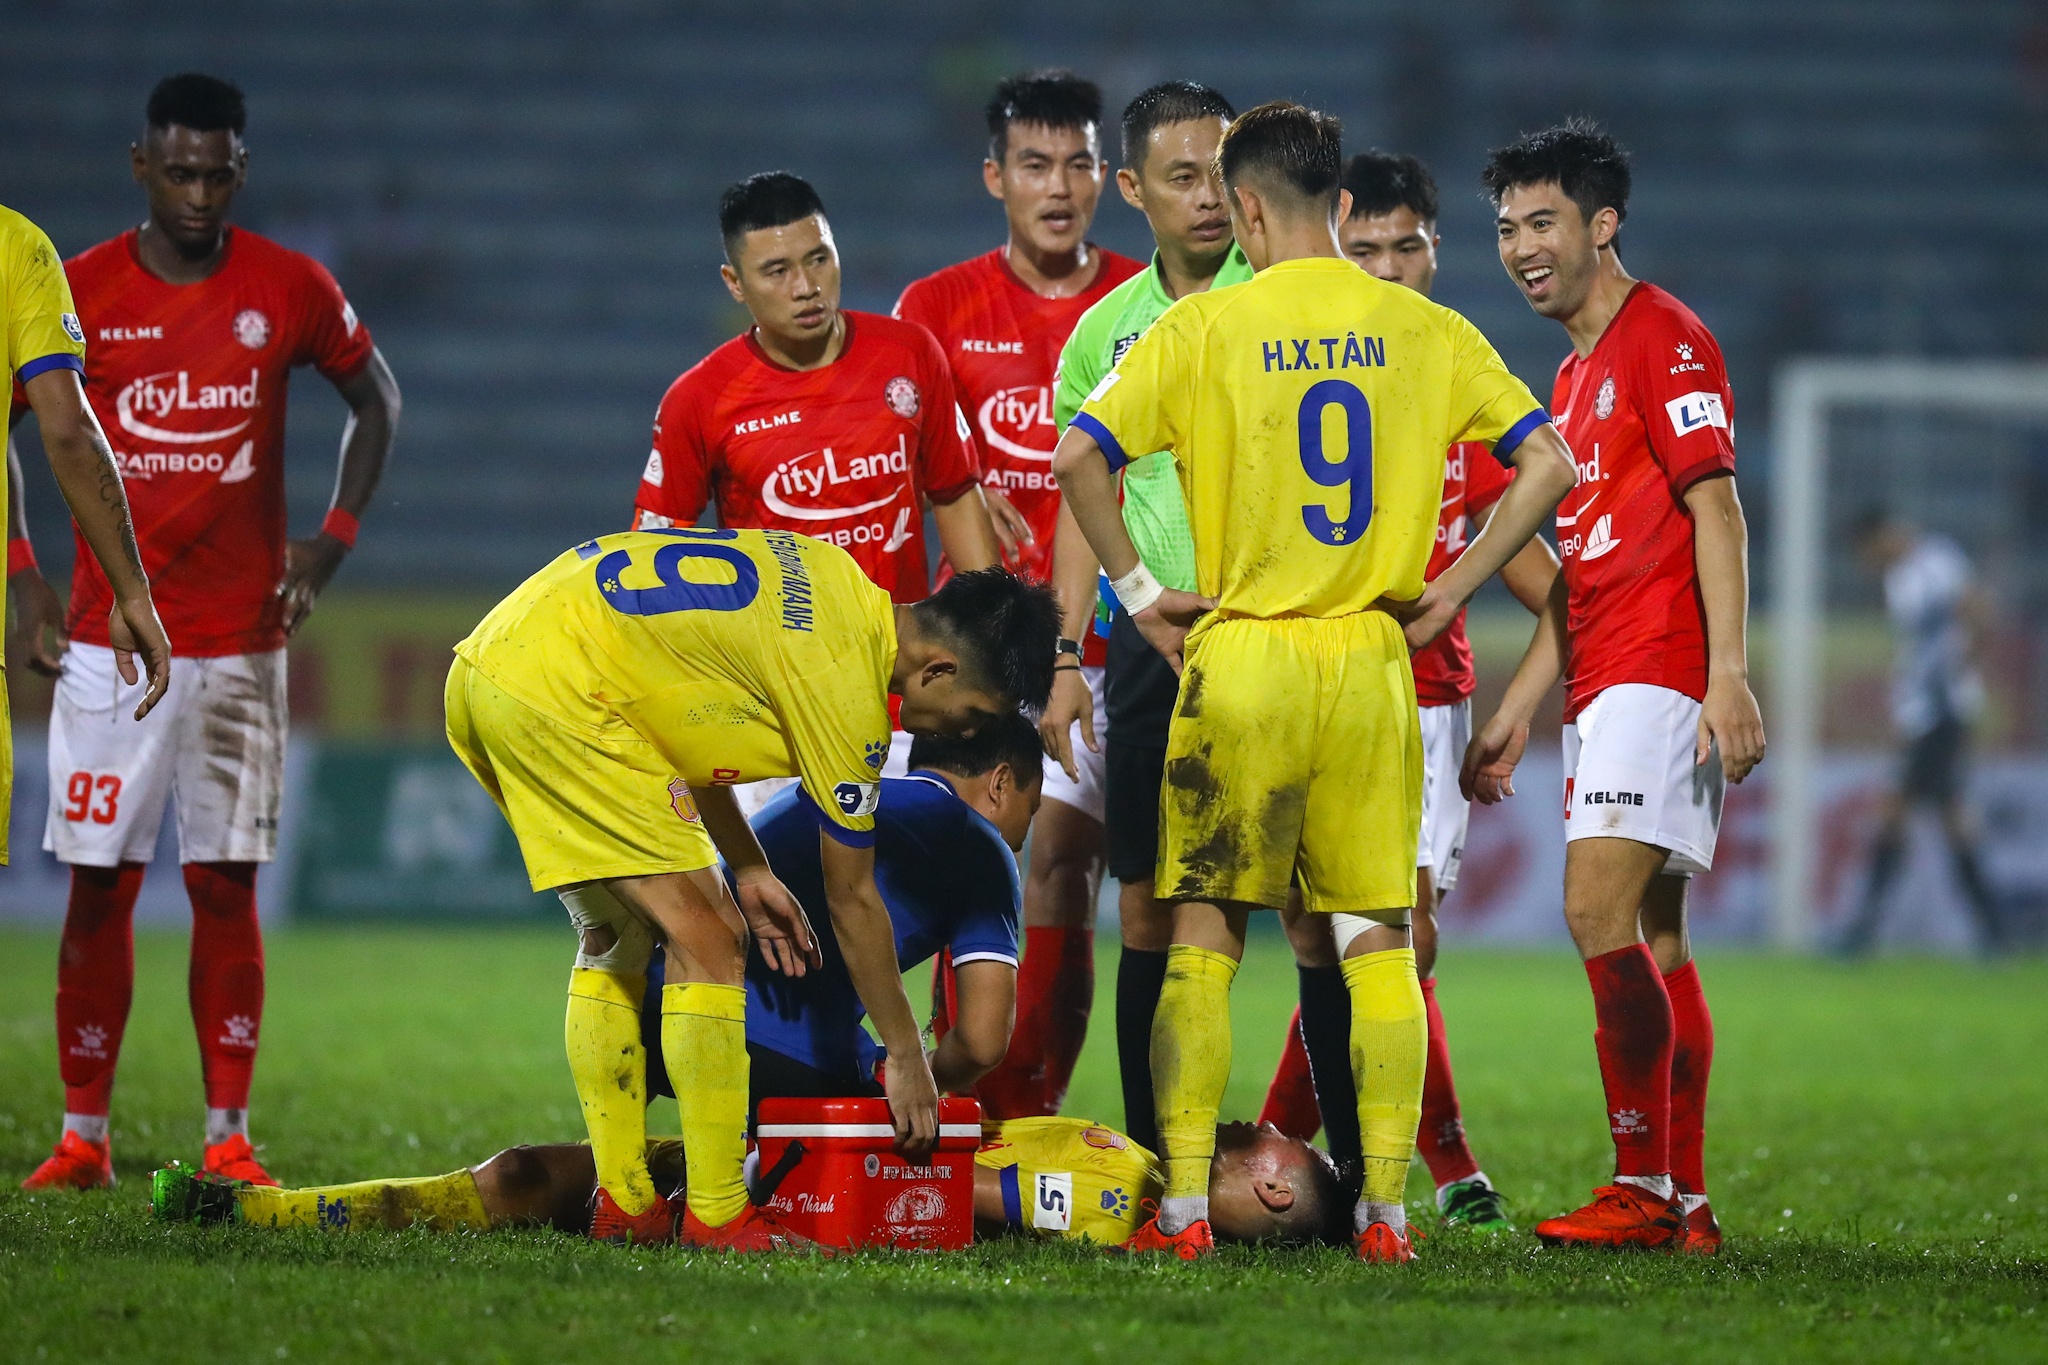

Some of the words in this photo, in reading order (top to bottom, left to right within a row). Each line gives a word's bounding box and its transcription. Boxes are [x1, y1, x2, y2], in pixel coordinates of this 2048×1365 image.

[100, 326, 163, 341] KELME
[962, 339, 1024, 355] KELME
[1262, 331, 1386, 372] H.X.TÂN
[1669, 362, 1706, 375] KELME
[117, 367, 260, 444] CityLand
[735, 411, 801, 436] KELME
[978, 385, 1056, 461] CityL
[1298, 379, 1373, 546] 9
[762, 433, 910, 521] CityLand
[984, 468, 1060, 491] AMBO
[66, 771, 122, 825] 93
[1585, 791, 1644, 806] KELME
[797, 1192, 835, 1214] Thành
